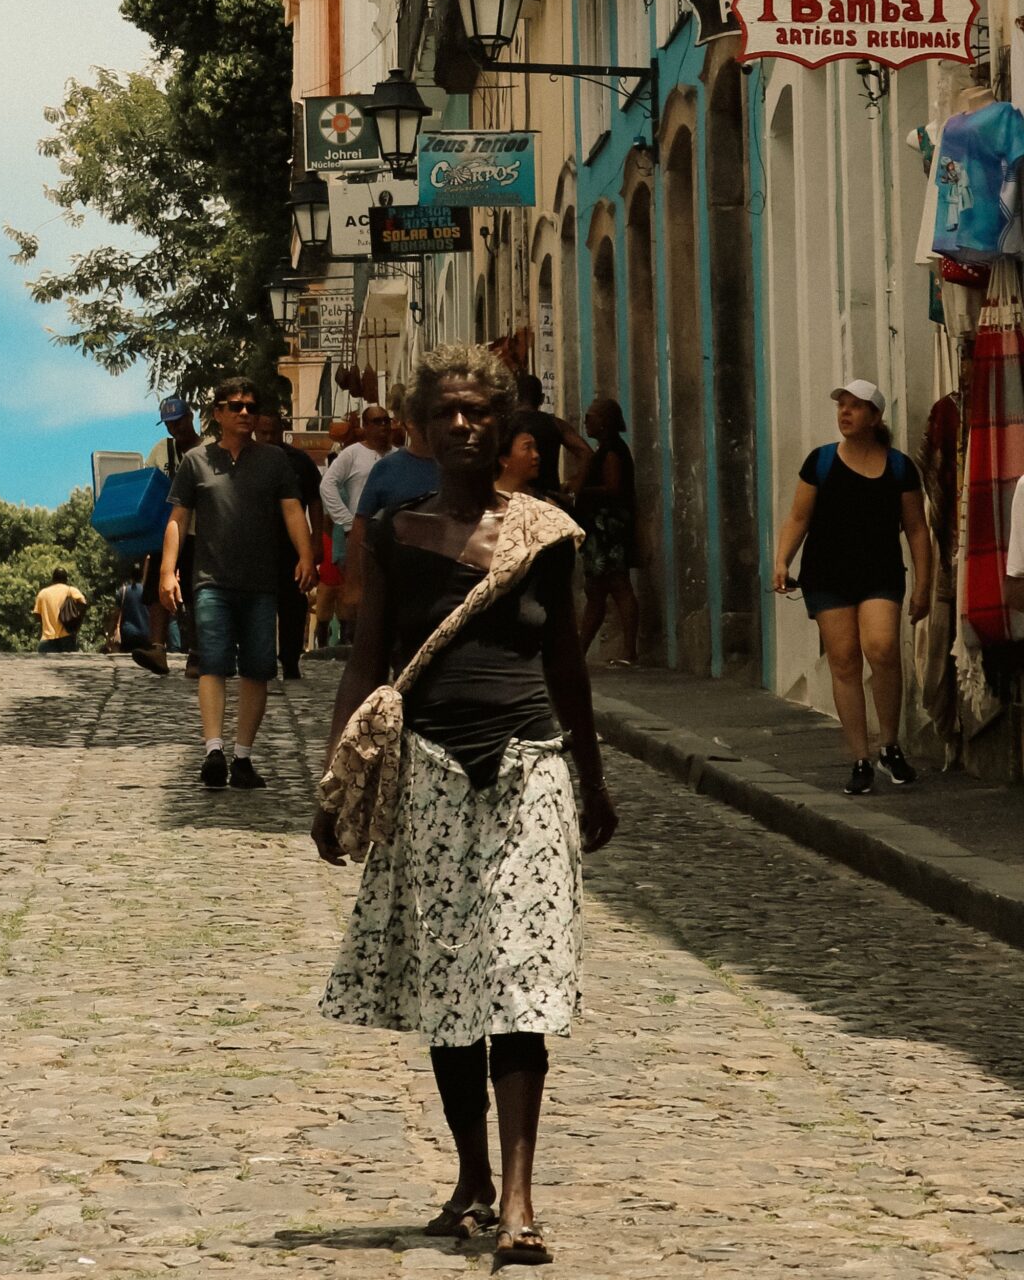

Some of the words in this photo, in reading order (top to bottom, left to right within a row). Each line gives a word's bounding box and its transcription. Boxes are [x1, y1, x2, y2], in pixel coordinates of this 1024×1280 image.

[422, 136, 469, 153] Zeus
[471, 136, 530, 153] Tattoo
[324, 149, 362, 160] Johrei
[311, 160, 341, 169] Núcleo
[382, 228, 428, 242] SOLAR
[433, 226, 461, 239] DOS
[390, 238, 454, 252] ROMANOS
